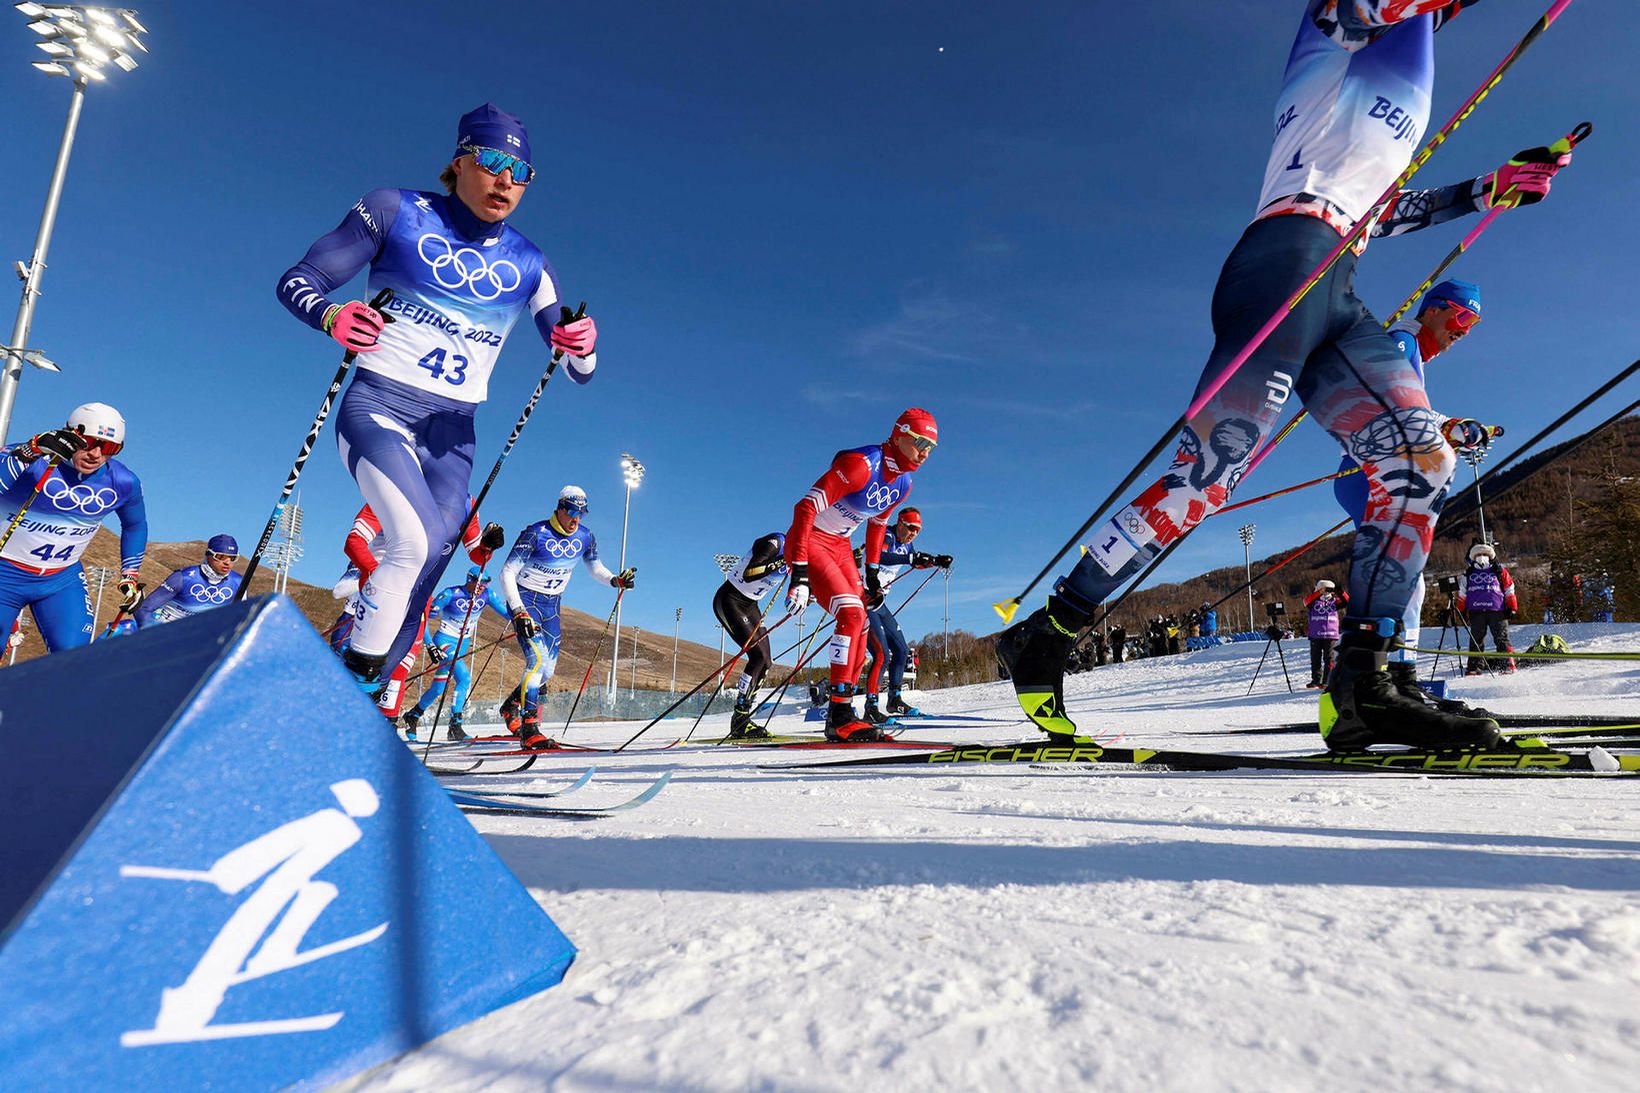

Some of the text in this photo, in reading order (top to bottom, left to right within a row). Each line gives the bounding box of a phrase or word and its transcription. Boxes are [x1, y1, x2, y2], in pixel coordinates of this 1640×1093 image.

[1286, 149, 1303, 171] 1
[283, 277, 324, 313] FIN
[388, 297, 502, 347] BEIJING 2022
[417, 347, 468, 386] 43
[30, 543, 75, 561] 44
[1101, 535, 1118, 554] 1
[543, 579, 564, 590] 17
[834, 648, 841, 658] 2
[928, 747, 1104, 763] FISCHER
